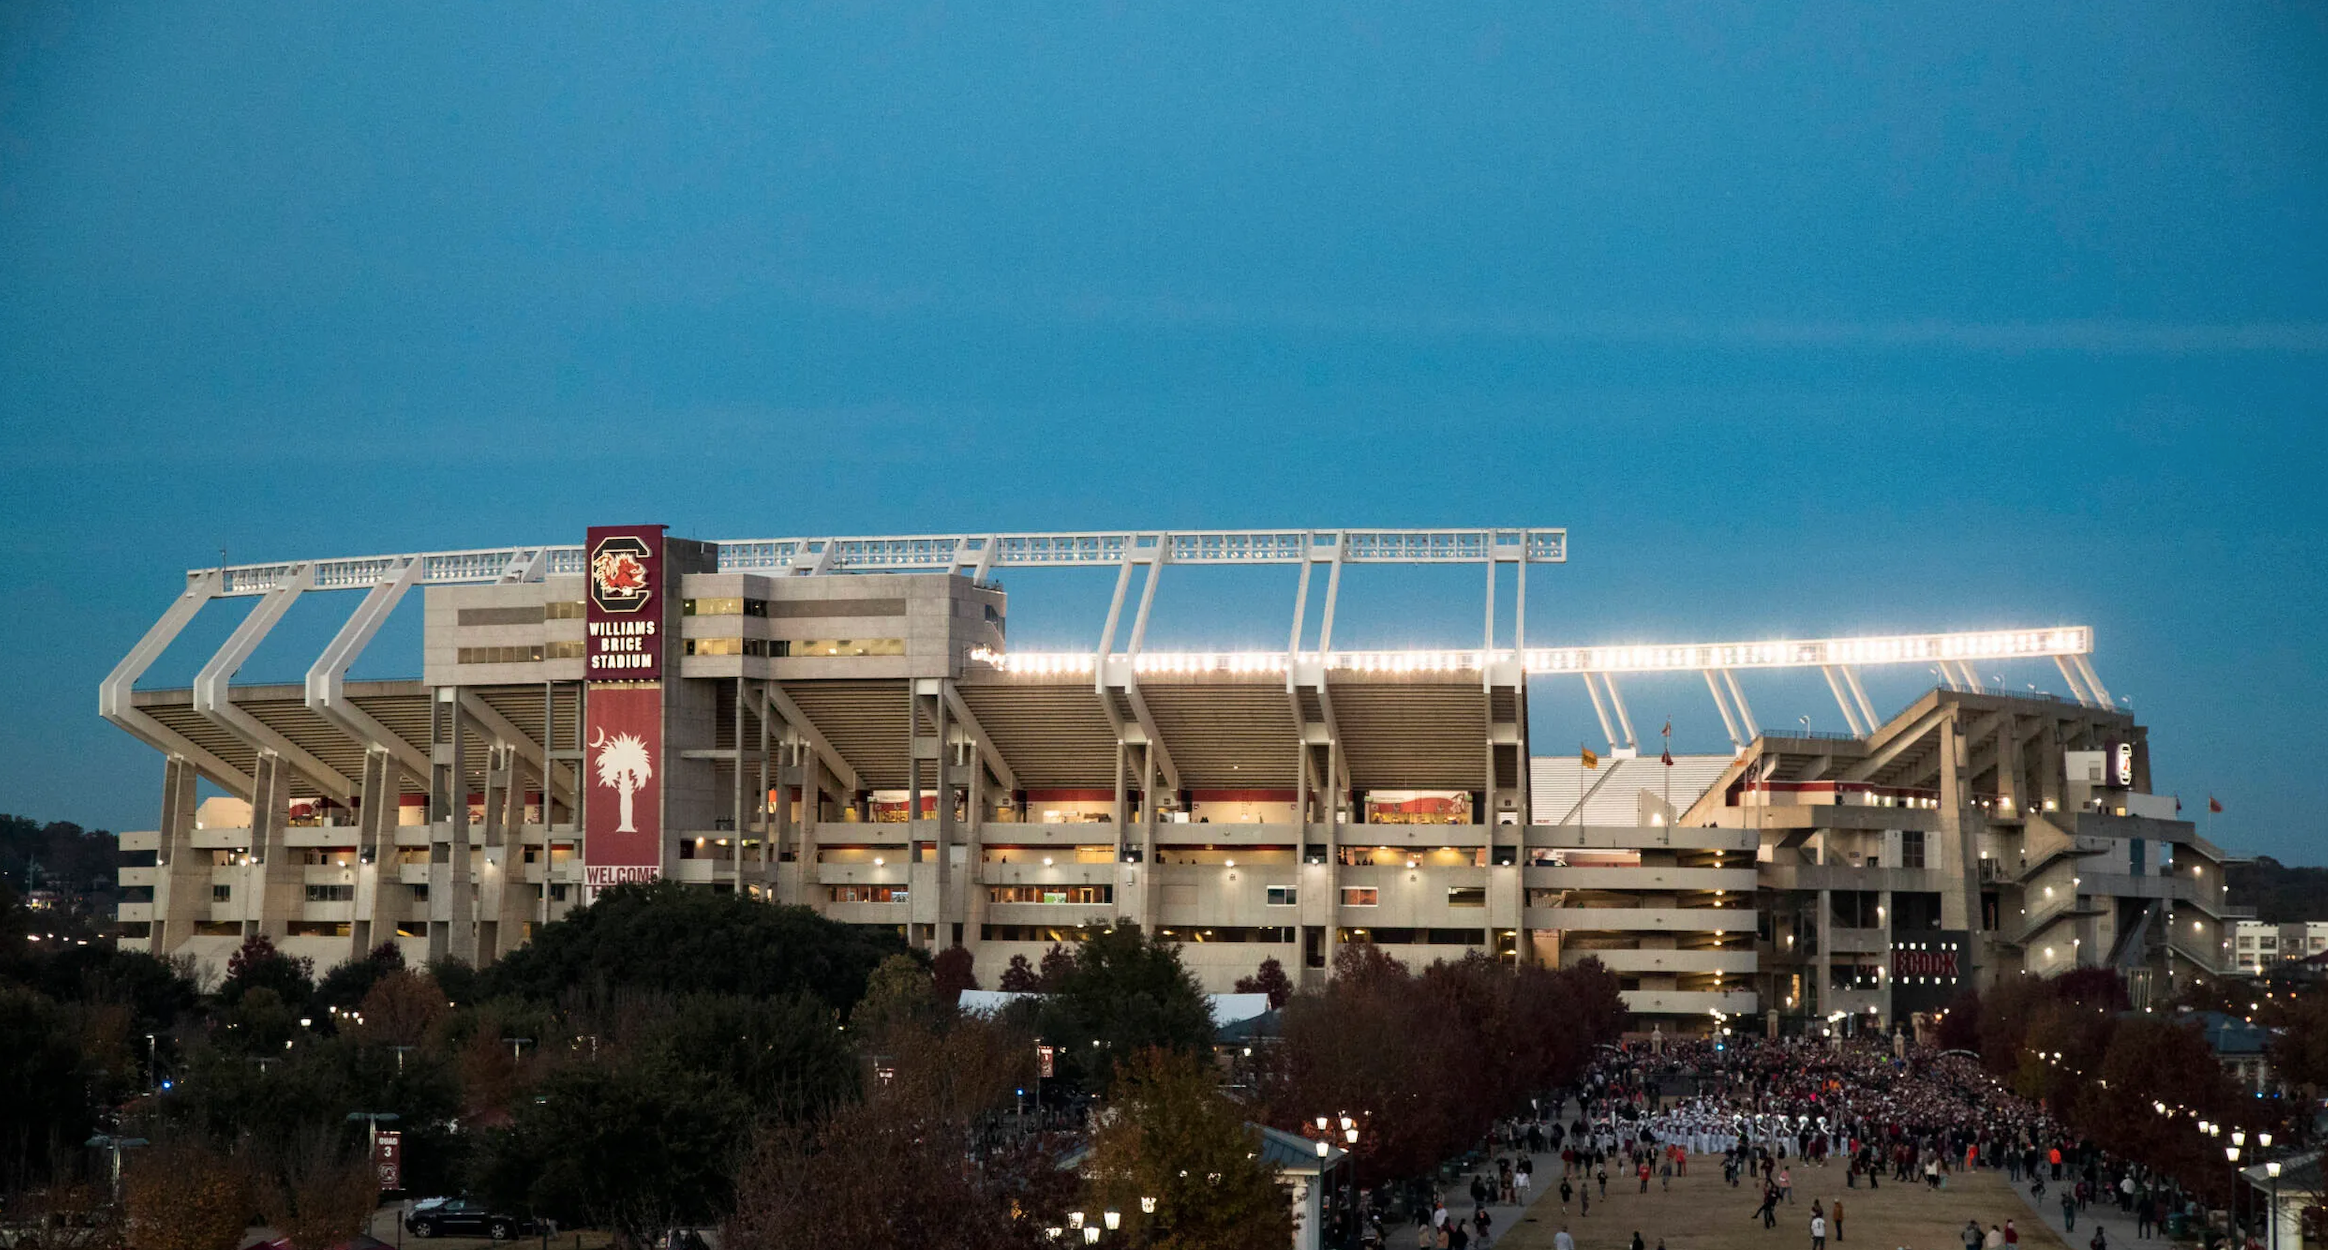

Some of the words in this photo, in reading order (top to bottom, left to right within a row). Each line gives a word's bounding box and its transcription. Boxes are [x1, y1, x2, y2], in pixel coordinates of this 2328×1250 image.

[589, 621, 655, 636] WILLIAMS
[601, 637, 642, 651] BRICE
[591, 654, 652, 669] STADIUM
[586, 867, 658, 884] WELCOME
[378, 1137, 398, 1146] QUAD
[383, 1145, 393, 1157] 3
